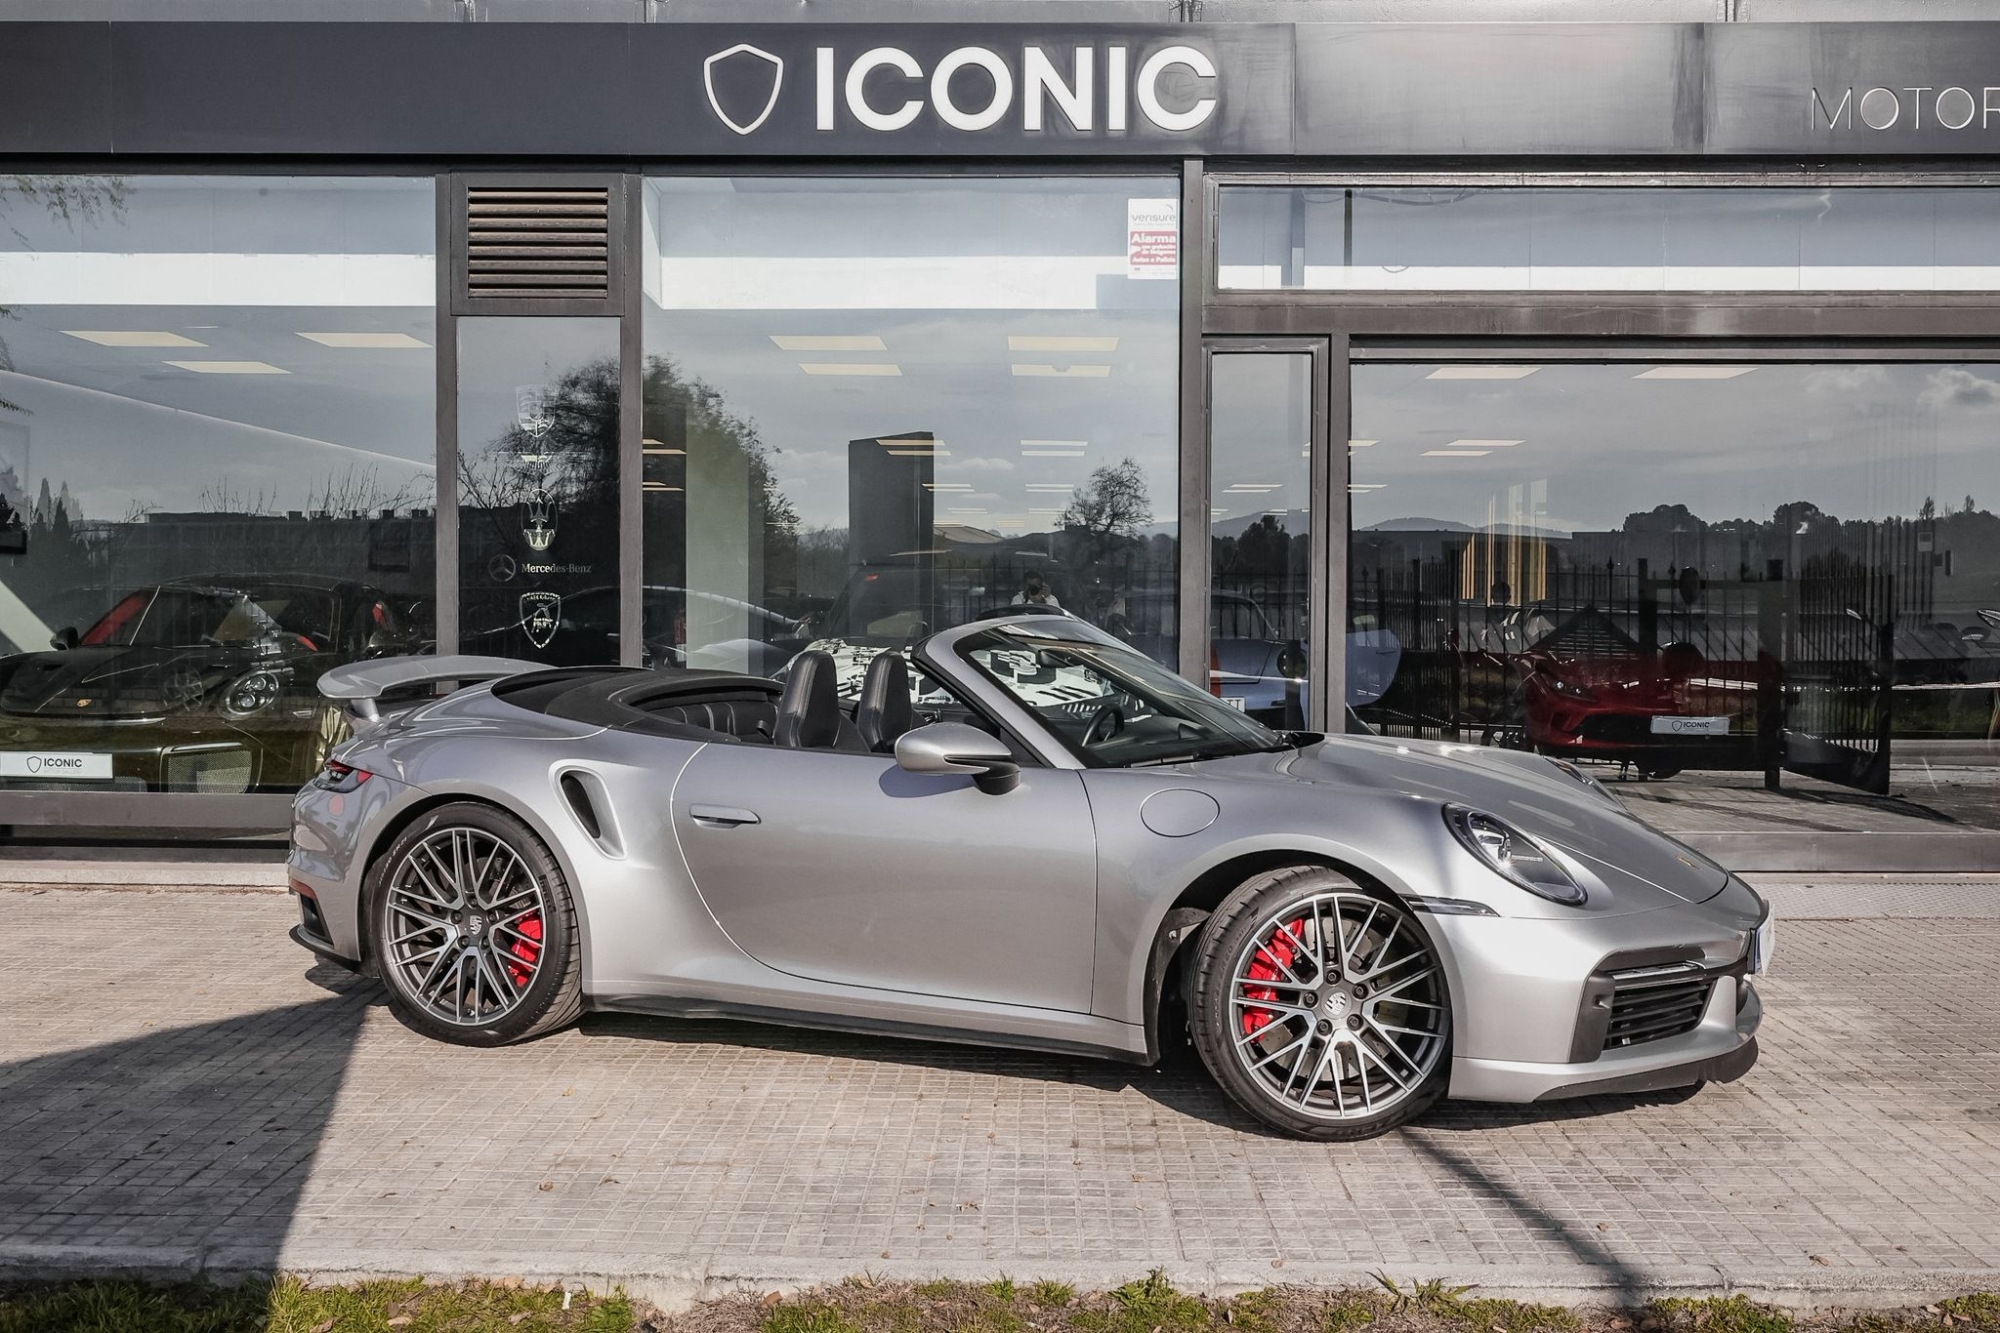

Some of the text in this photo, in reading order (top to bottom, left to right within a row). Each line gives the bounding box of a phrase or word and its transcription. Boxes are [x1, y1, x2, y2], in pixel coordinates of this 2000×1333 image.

[816, 46, 1216, 131] ICONIC
[1131, 213, 1176, 222] verisure
[1131, 232, 1176, 243] Alarma
[521, 563, 592, 573] Mercedes-Benz
[44, 758, 82, 768] ICONIC
